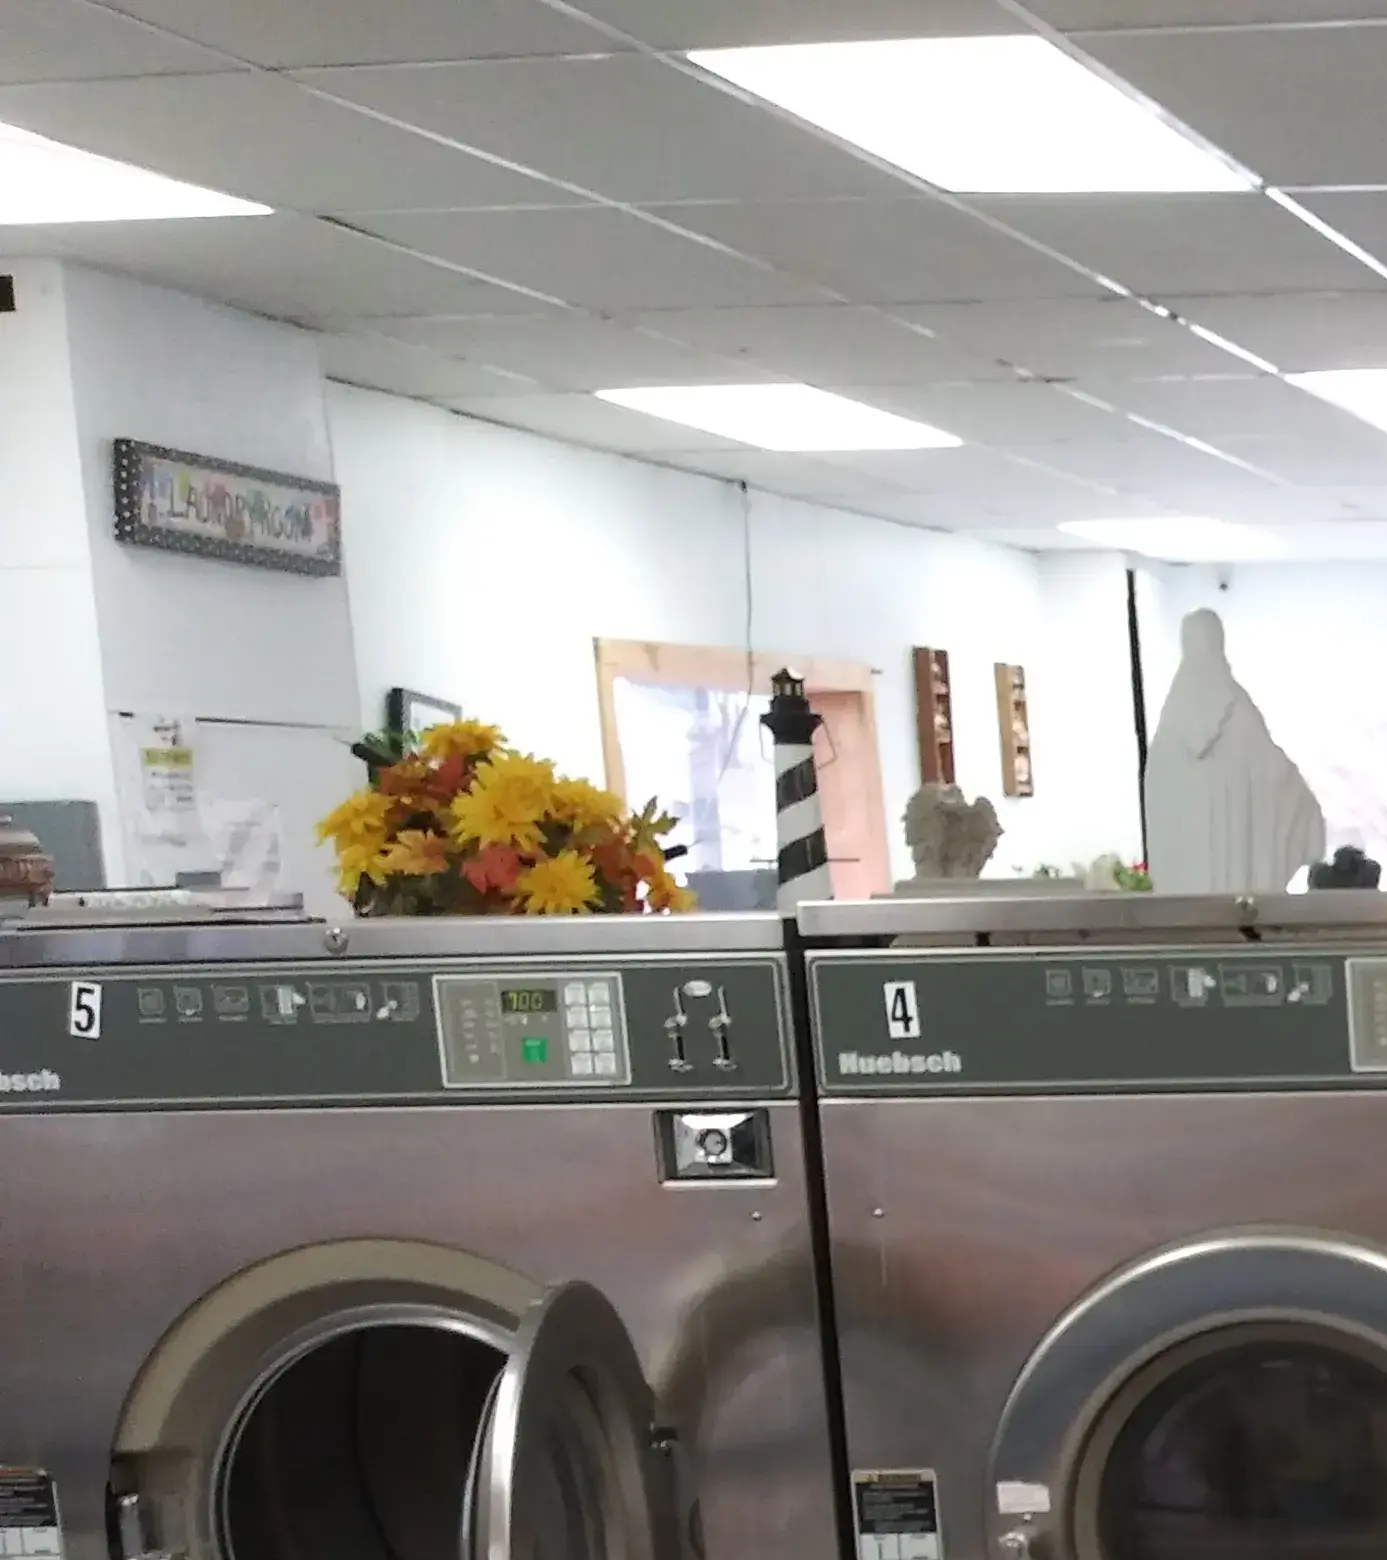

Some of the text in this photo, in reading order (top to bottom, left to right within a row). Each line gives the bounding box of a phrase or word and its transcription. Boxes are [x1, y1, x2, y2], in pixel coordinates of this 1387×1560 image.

[74, 987, 96, 1032] 5
[891, 988, 914, 1033] 4
[838, 1050, 962, 1075] Huebsch
